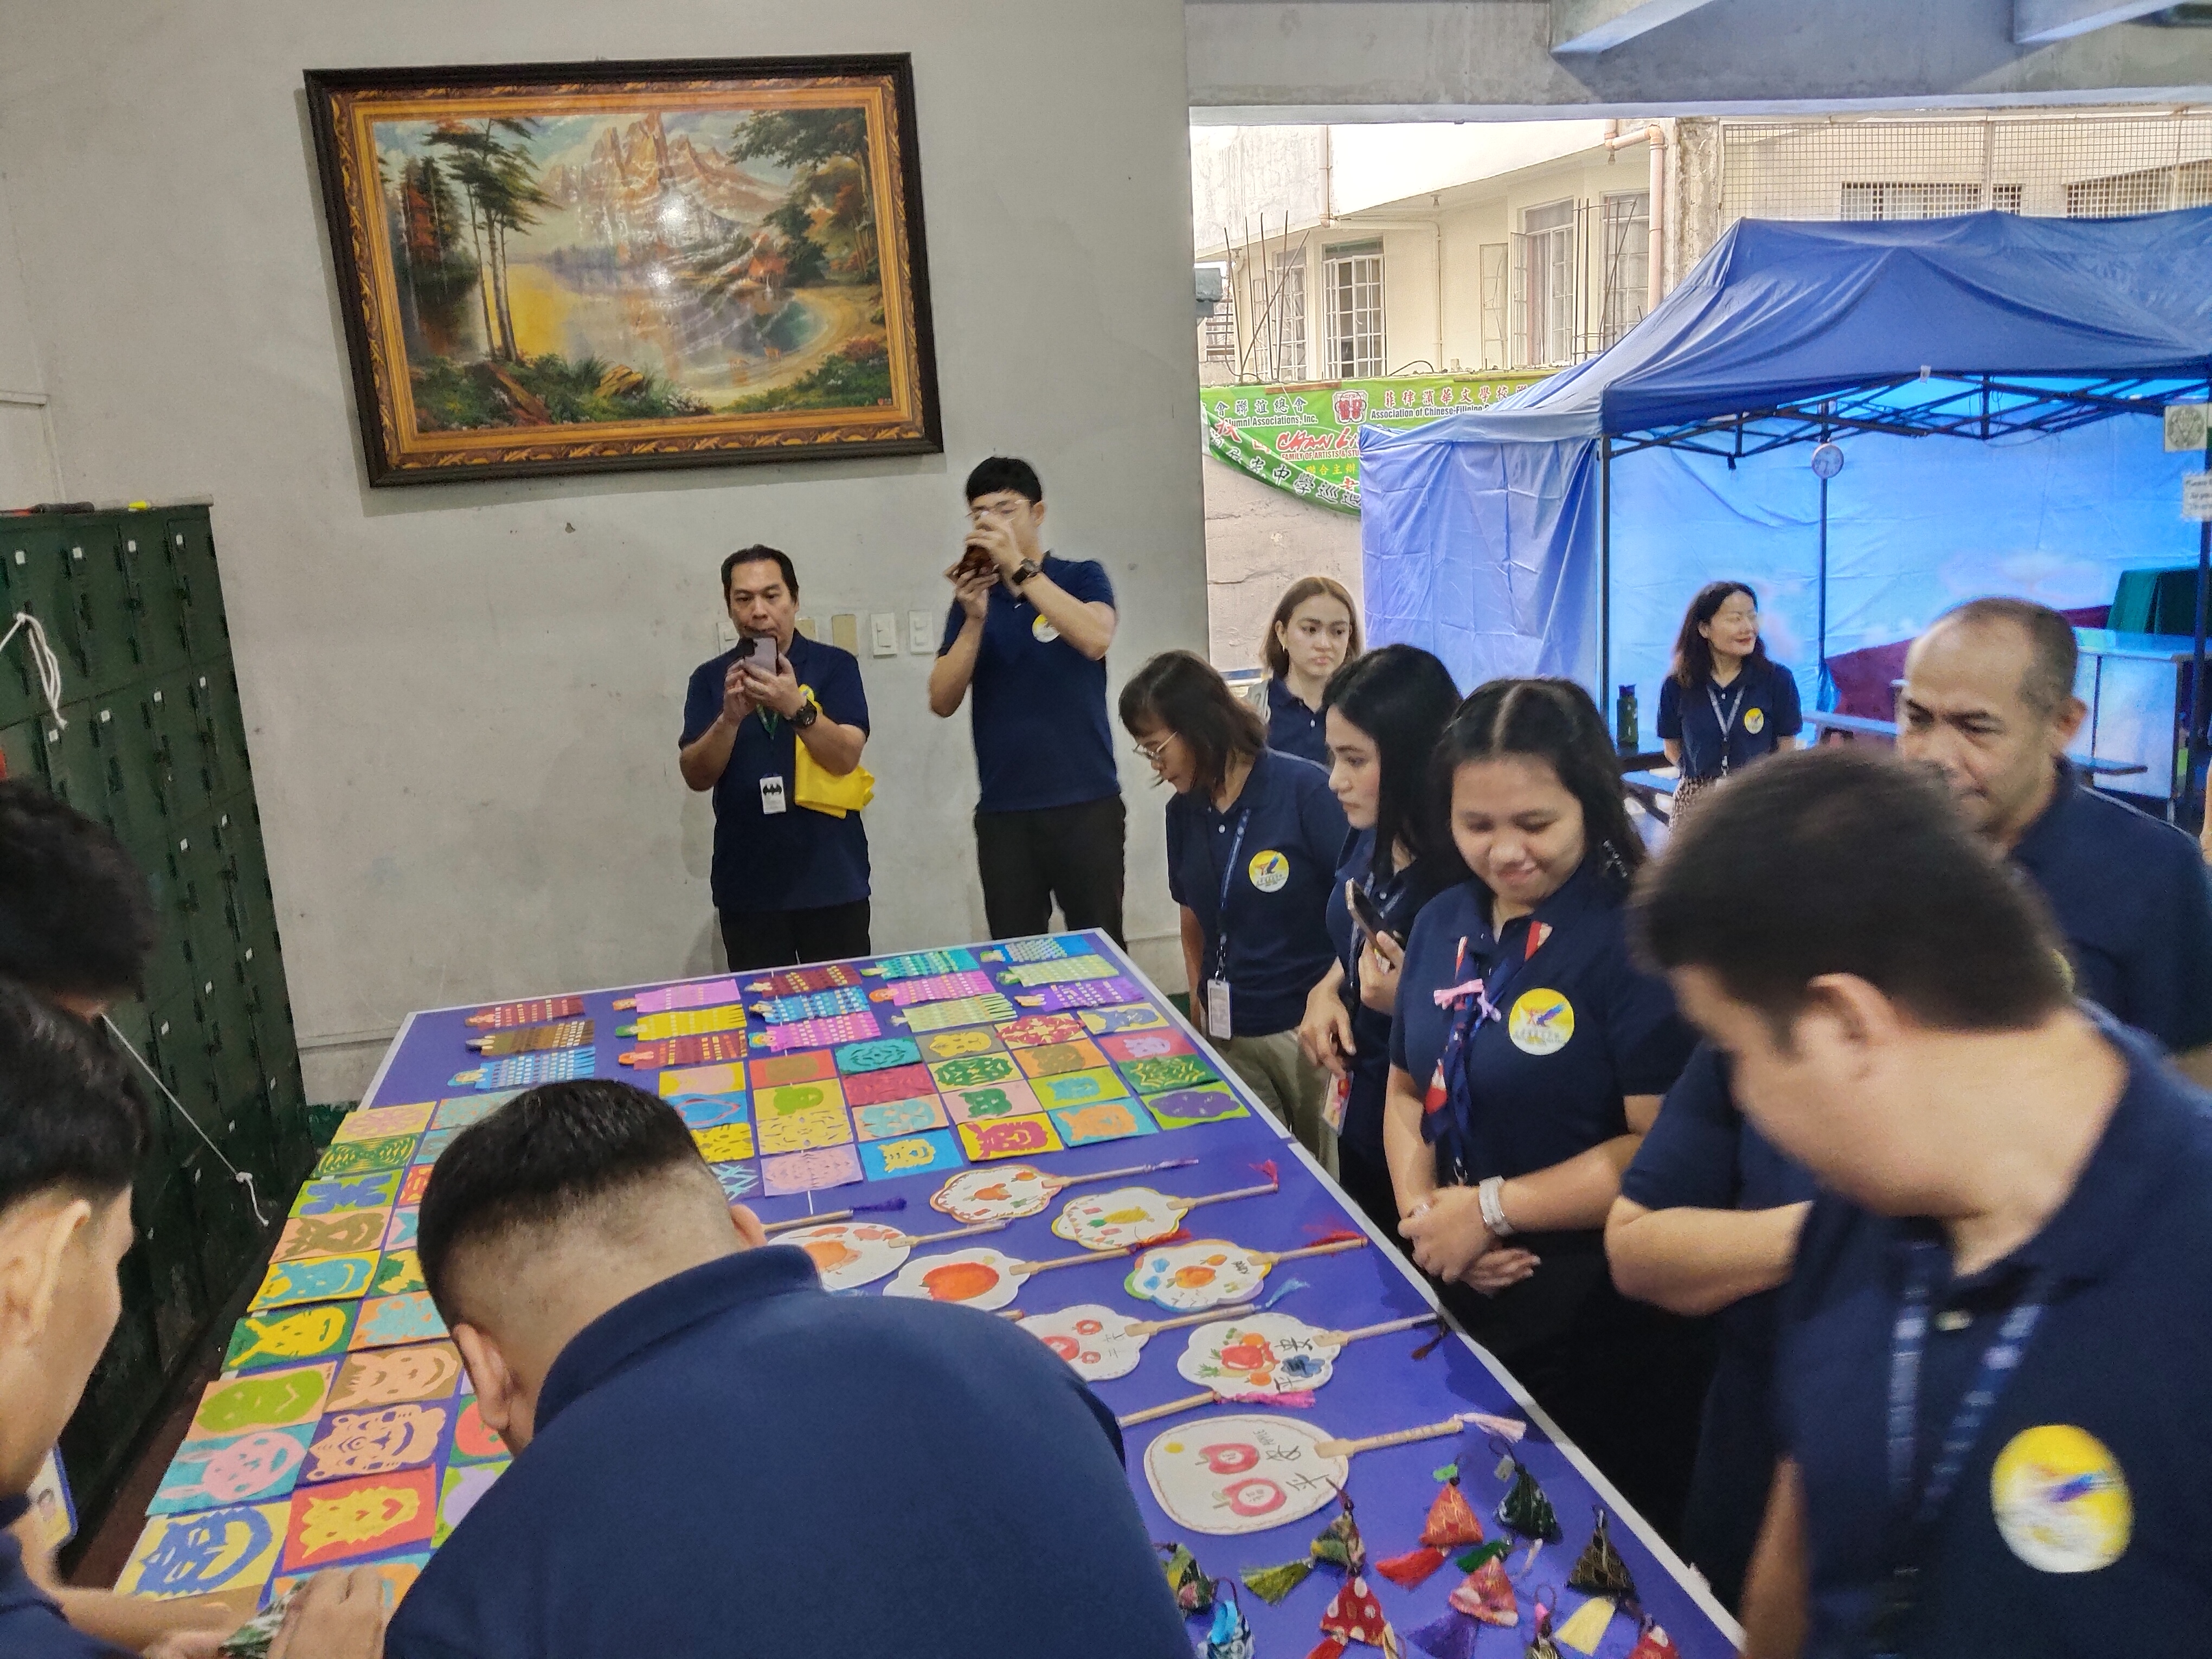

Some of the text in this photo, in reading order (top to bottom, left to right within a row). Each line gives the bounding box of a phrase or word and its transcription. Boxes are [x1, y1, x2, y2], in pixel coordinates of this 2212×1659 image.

[1372, 408, 1412, 419] Association
[1414, 407, 1423, 417] of
[1252, 415, 1301, 427] Associations,
[1304, 414, 1317, 423] Inc.
[1282, 449, 1360, 461] FAMILY OF ARTISTS & STU
